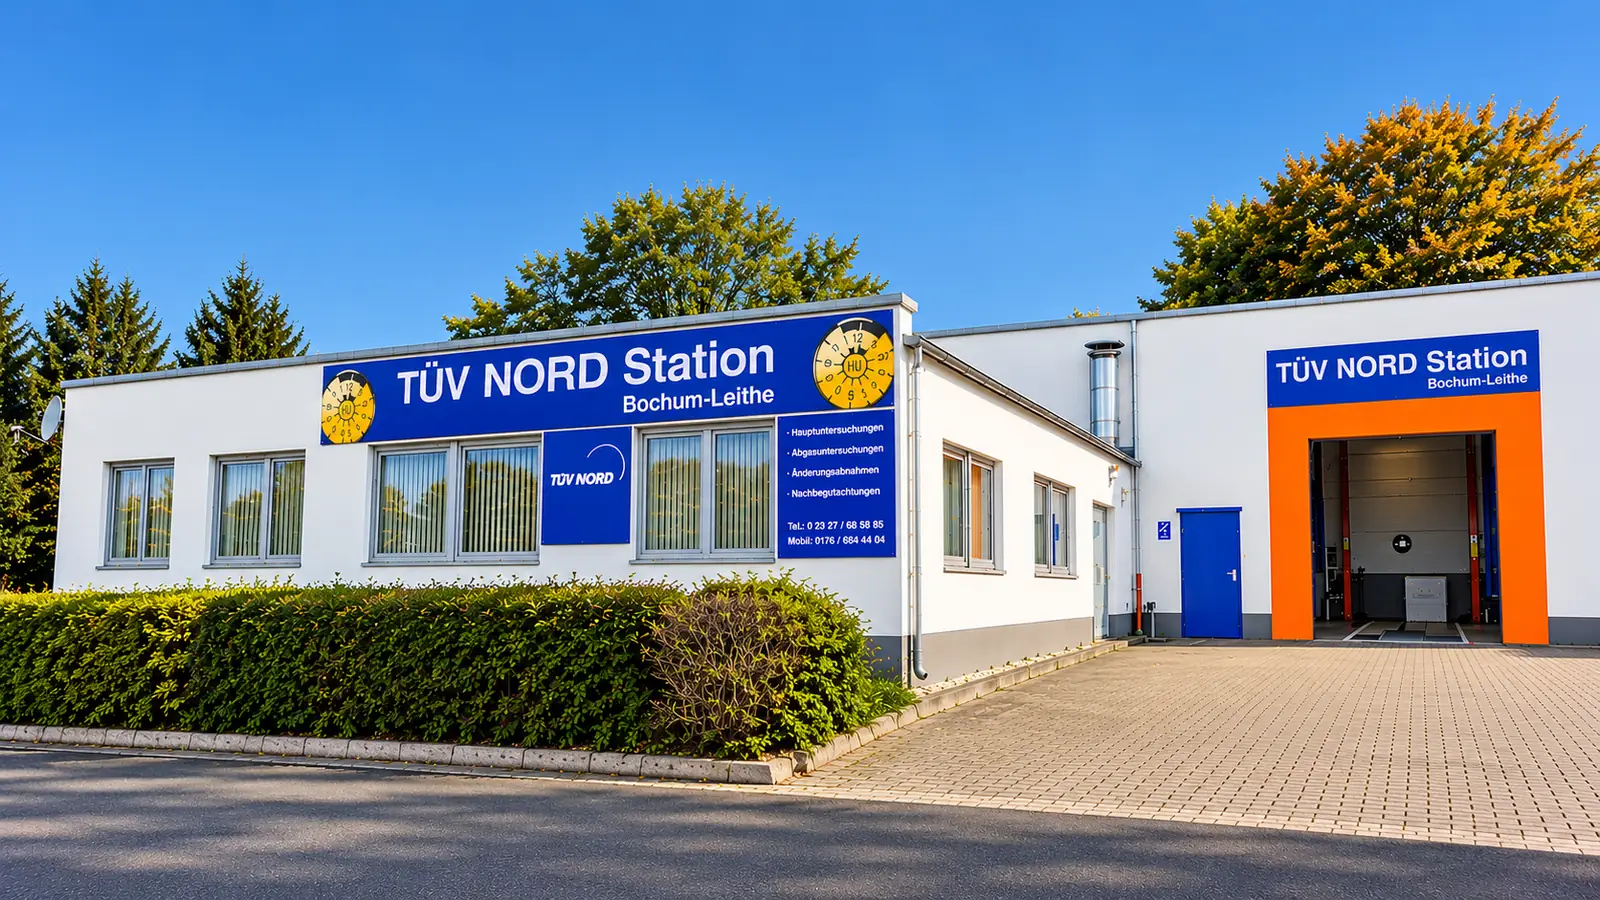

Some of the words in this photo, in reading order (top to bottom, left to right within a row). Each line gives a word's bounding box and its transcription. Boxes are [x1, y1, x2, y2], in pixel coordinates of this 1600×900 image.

[853, 333, 863, 343] 12
[847, 360, 862, 372] HU
[1276, 356, 1328, 383] TÜV
[1338, 353, 1417, 379] NORD
[1427, 347, 1527, 373] Station
[397, 361, 470, 404] TÜV
[484, 353, 608, 397] NORD
[624, 340, 774, 385] Station
[1428, 373, 1527, 389] Bochum-Leithe
[623, 386, 774, 413] Bochum-Leithe
[791, 424, 884, 437] Hauptuntersuchungen
[791, 445, 884, 458] Abgasuntersuchungen
[791, 466, 879, 478] Änderungsabnahmen
[551, 473, 575, 486] TÜV
[575, 472, 614, 485] NORD
[791, 487, 880, 498] Nachbegutachtungen
[787, 521, 804, 530] Tel.:
[807, 521, 813, 530] 0
[814, 521, 825, 530] 23
[827, 521, 838, 530] 27
[873, 520, 884, 529] 85
[787, 536, 812, 545] Mobil:
[815, 536, 835, 545] 0176
[861, 535, 872, 544] 44
[874, 535, 885, 544] 04
